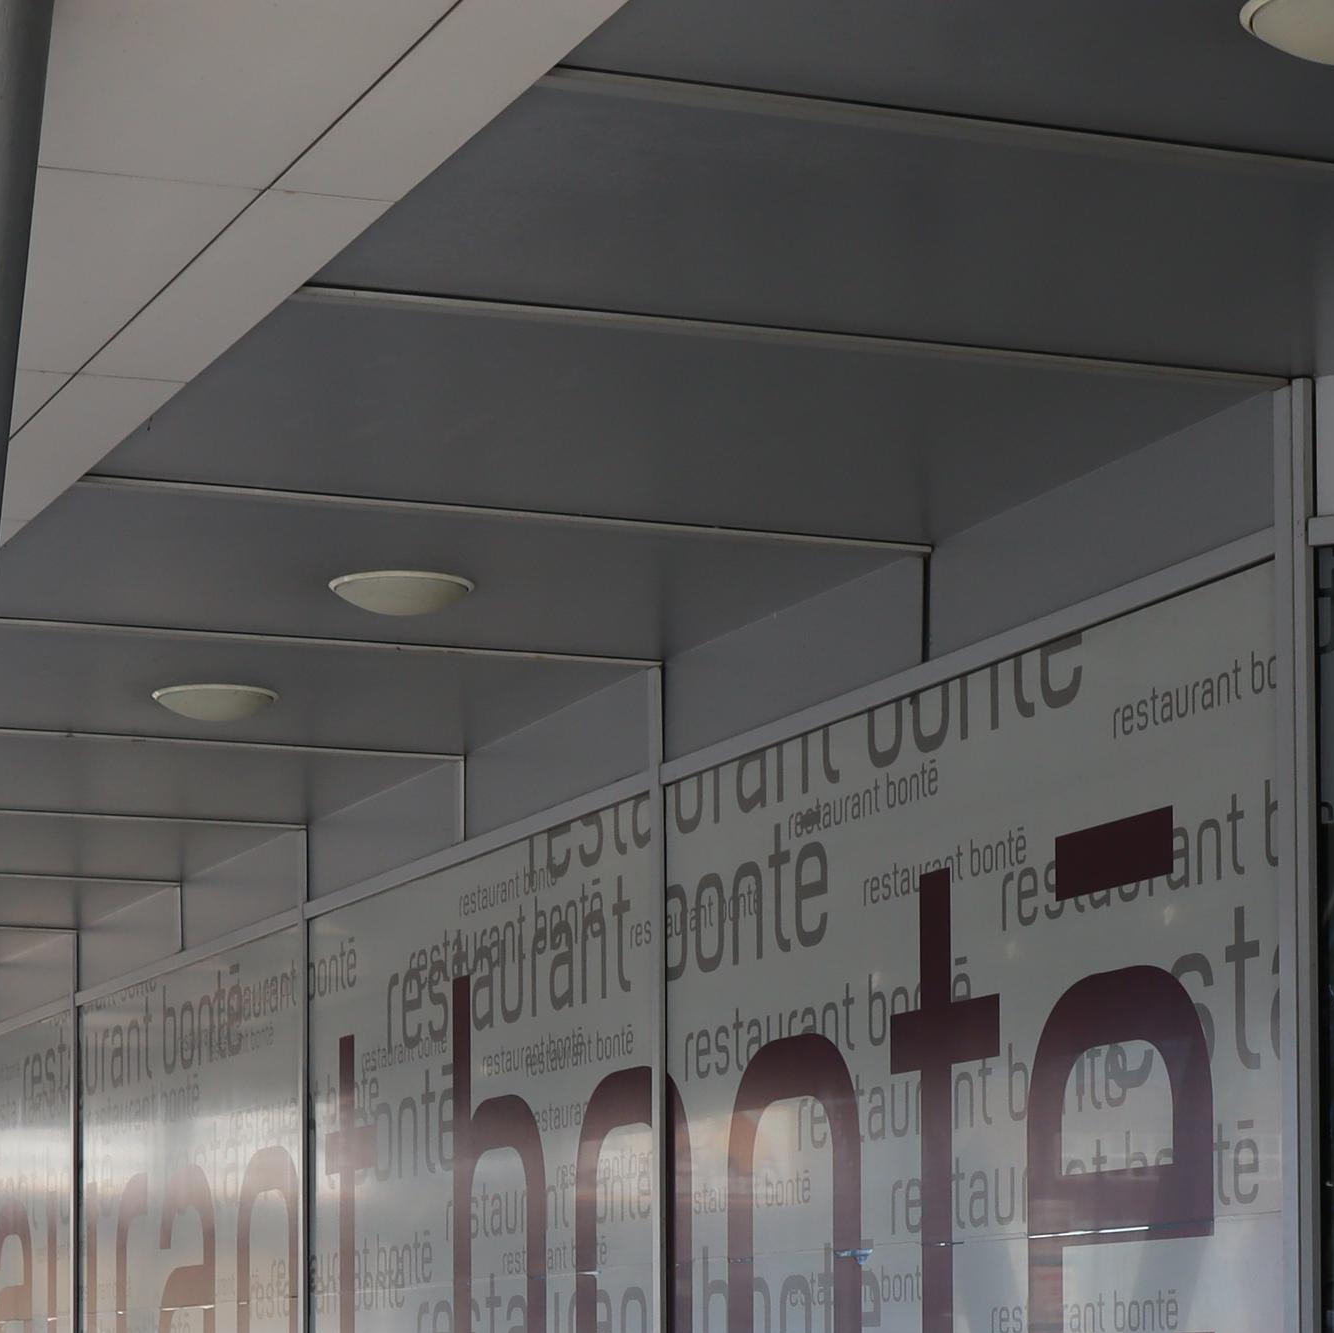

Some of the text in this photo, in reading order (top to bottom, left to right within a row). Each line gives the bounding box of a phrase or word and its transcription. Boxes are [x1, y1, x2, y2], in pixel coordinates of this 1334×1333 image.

[1113, 664, 1242, 740] restaurant
[886, 759, 939, 808] bontē
[970, 827, 1027, 878] bontē
[597, 1024, 634, 1062] bontē
[1113, 1289, 1179, 1333] bontē
